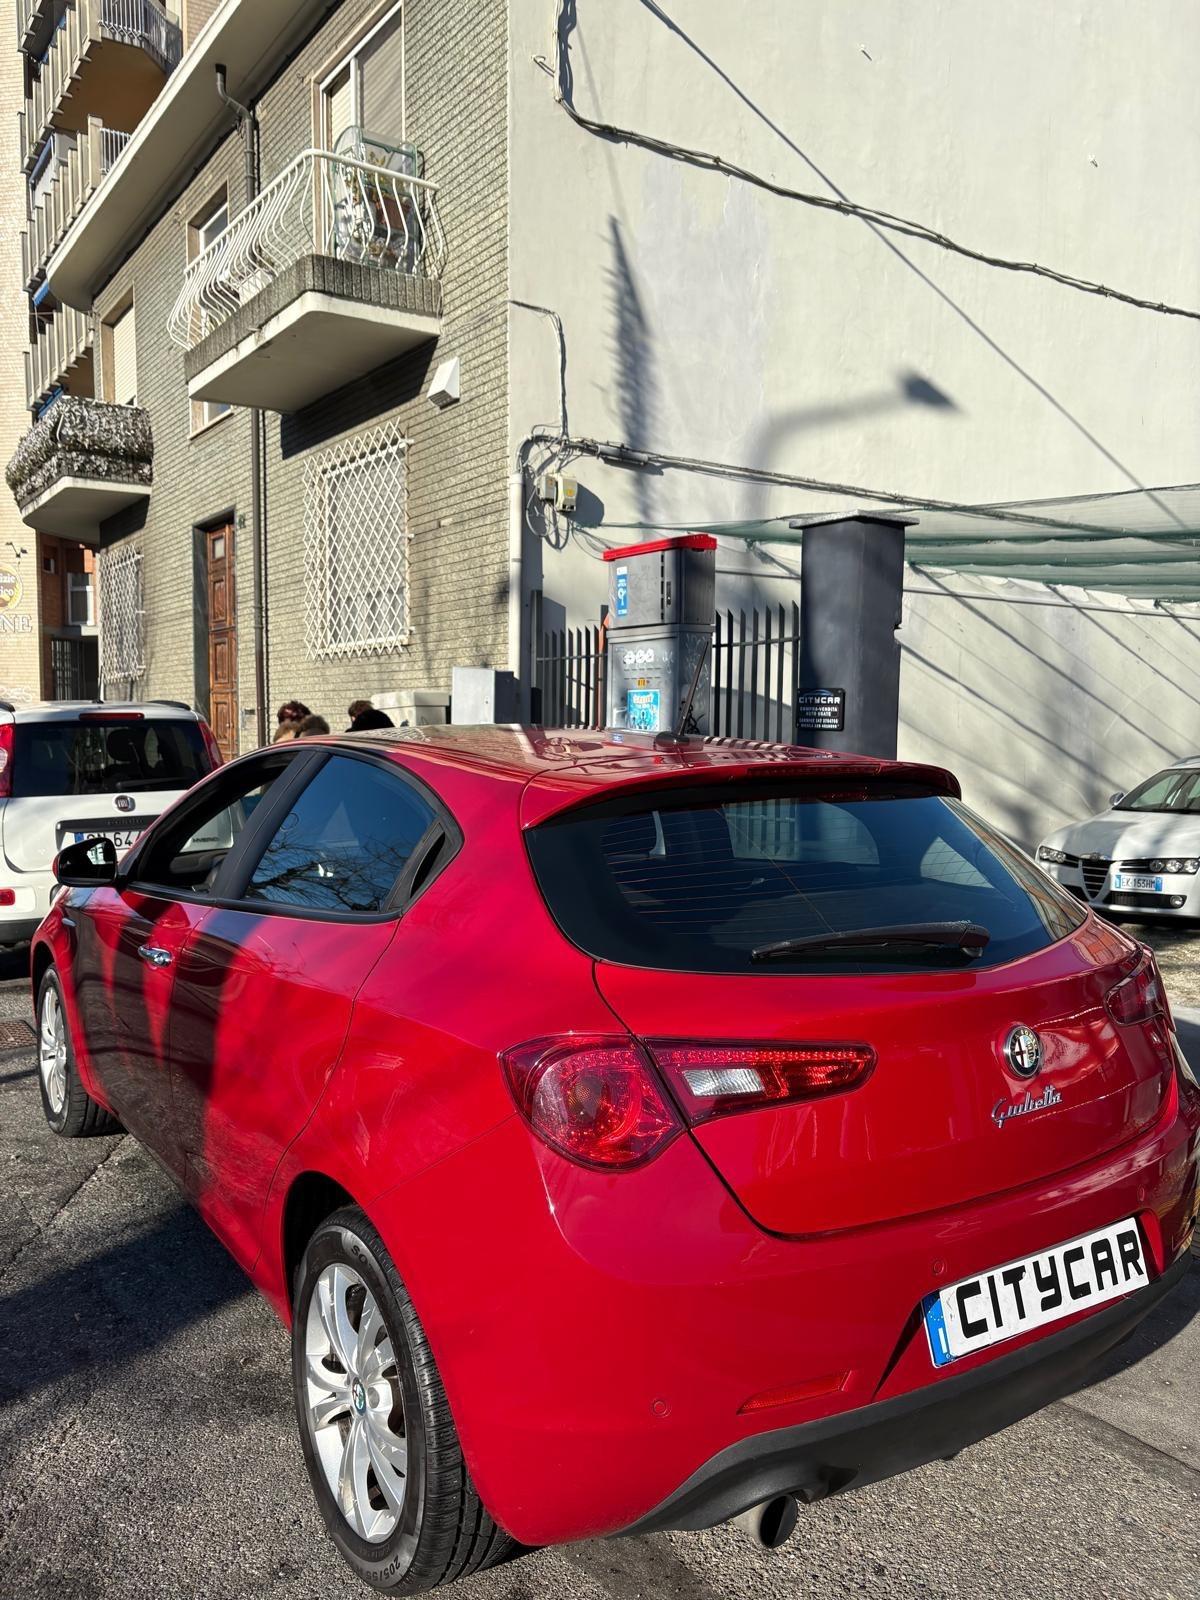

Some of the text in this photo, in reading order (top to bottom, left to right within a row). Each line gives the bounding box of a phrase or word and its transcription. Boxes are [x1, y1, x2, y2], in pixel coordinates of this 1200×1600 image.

[798, 696, 841, 704] CITYCAR
[991, 1084, 1063, 1129] Giulietta
[956, 1229, 1144, 1339] CITYCAR
